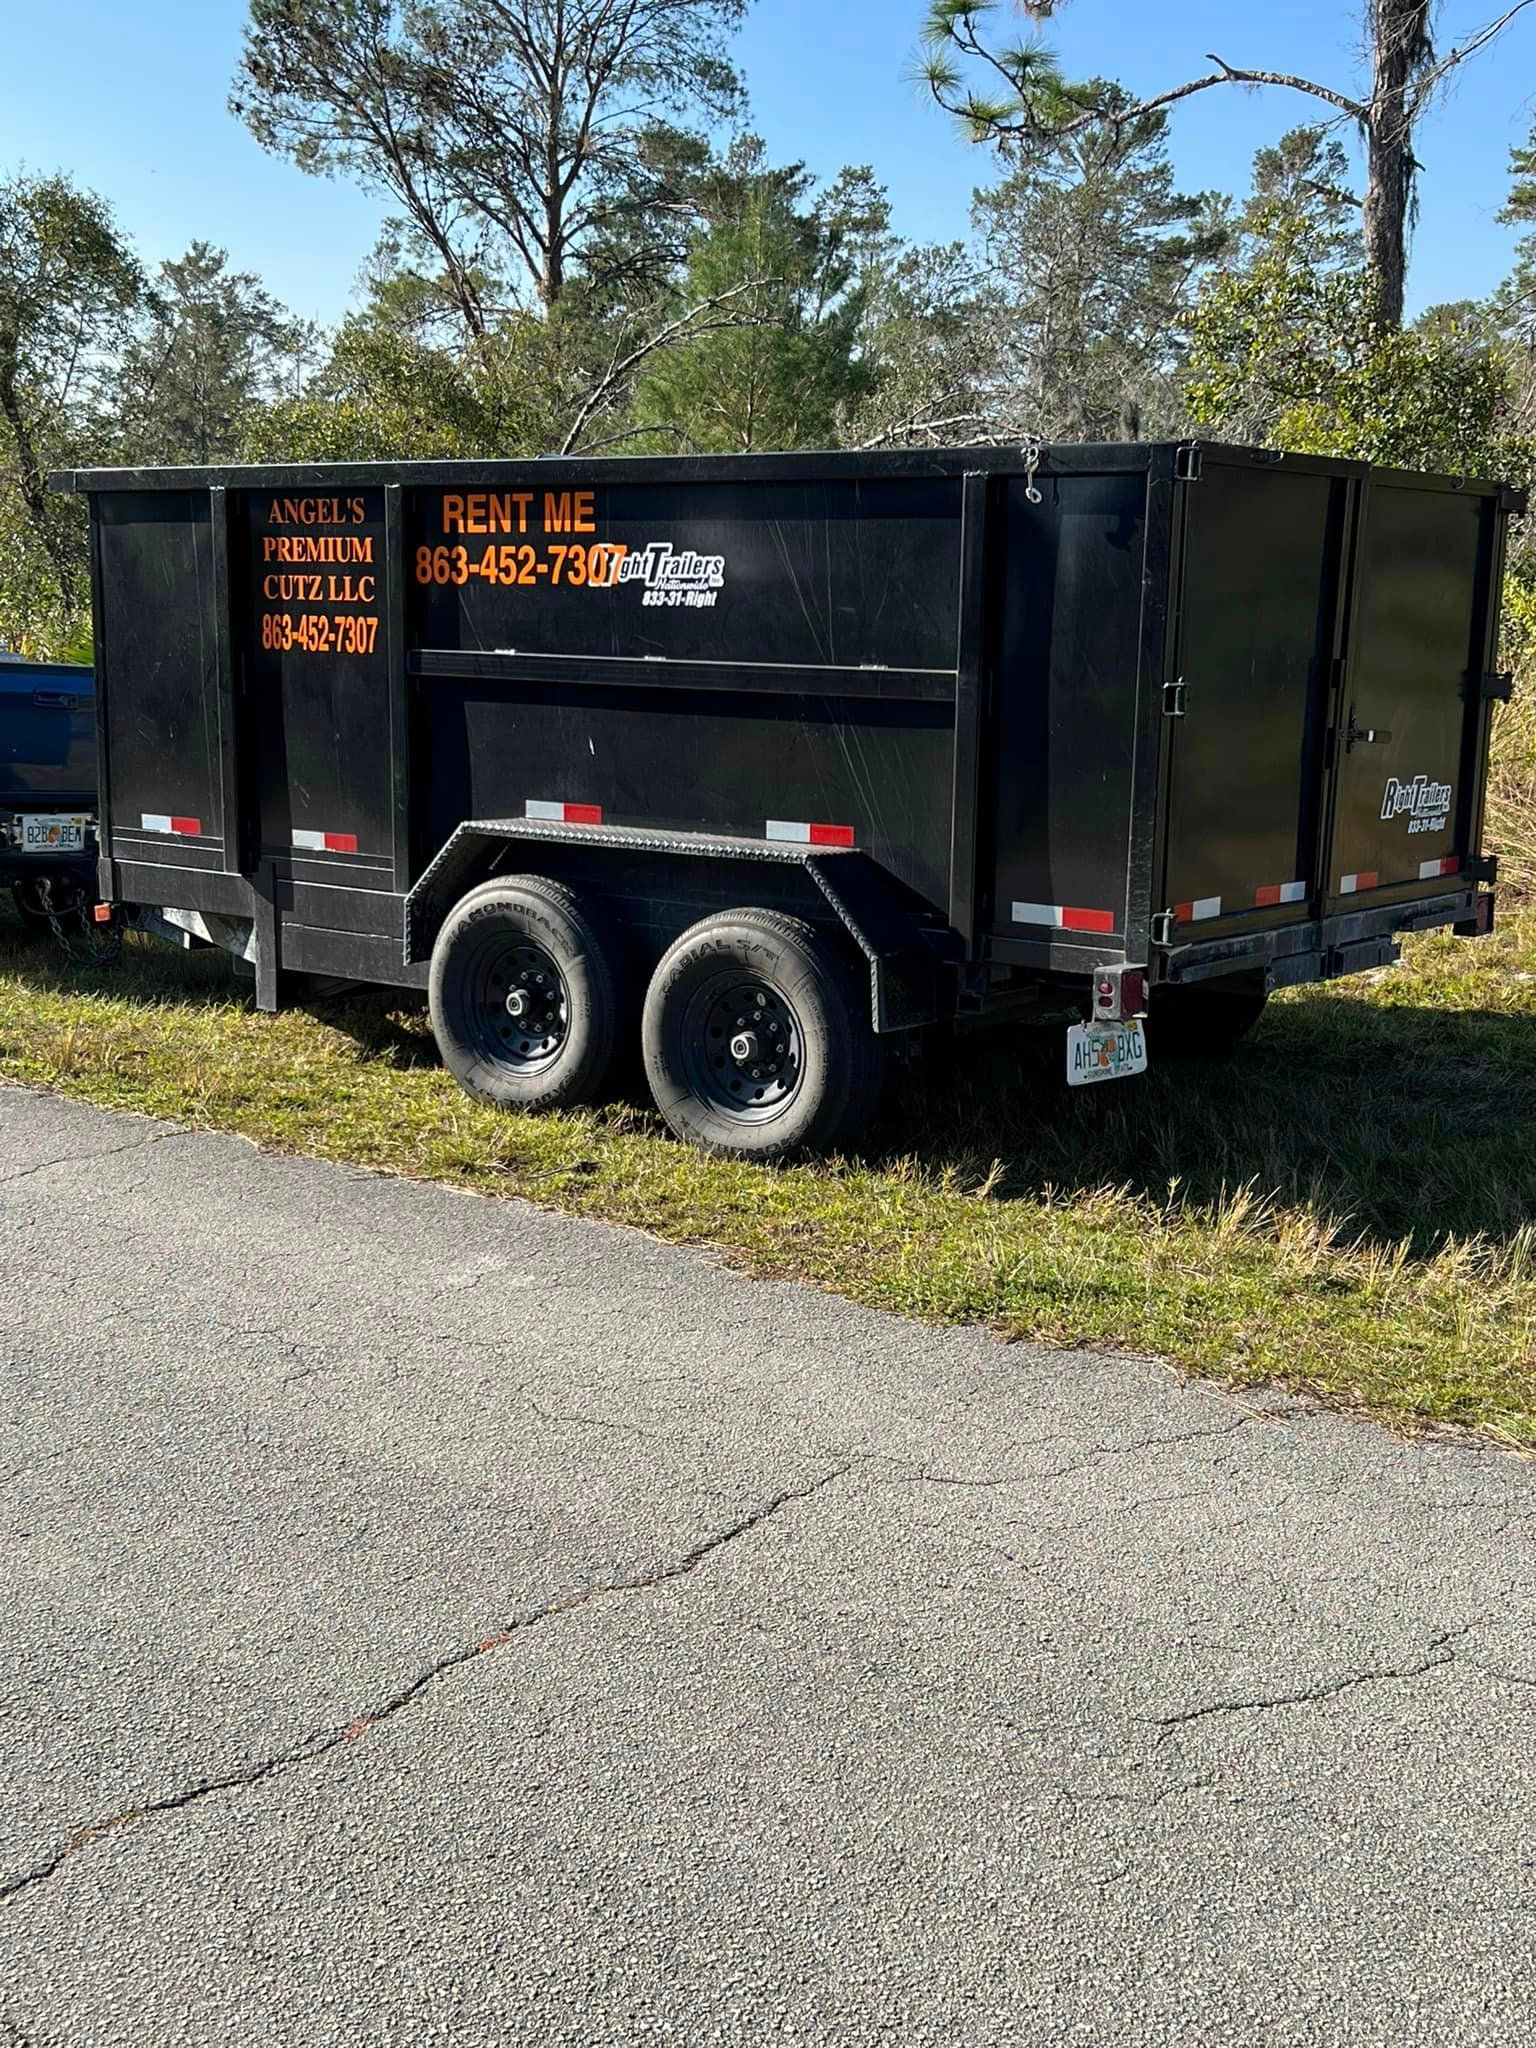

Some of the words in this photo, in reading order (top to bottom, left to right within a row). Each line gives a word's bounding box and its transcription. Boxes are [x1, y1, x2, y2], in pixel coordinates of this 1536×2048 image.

[268, 497, 365, 524] ANGEL'S
[443, 493, 534, 533] RENT
[544, 491, 596, 532] ME
[262, 537, 374, 562] PREMIUM
[415, 544, 628, 585] 863-452-7307
[645, 543, 725, 587] Trailers
[263, 574, 323, 601] CUTZ
[328, 576, 376, 602] LLC
[642, 591, 718, 608] 833-31-Right
[262, 614, 379, 654] 863-452-7307
